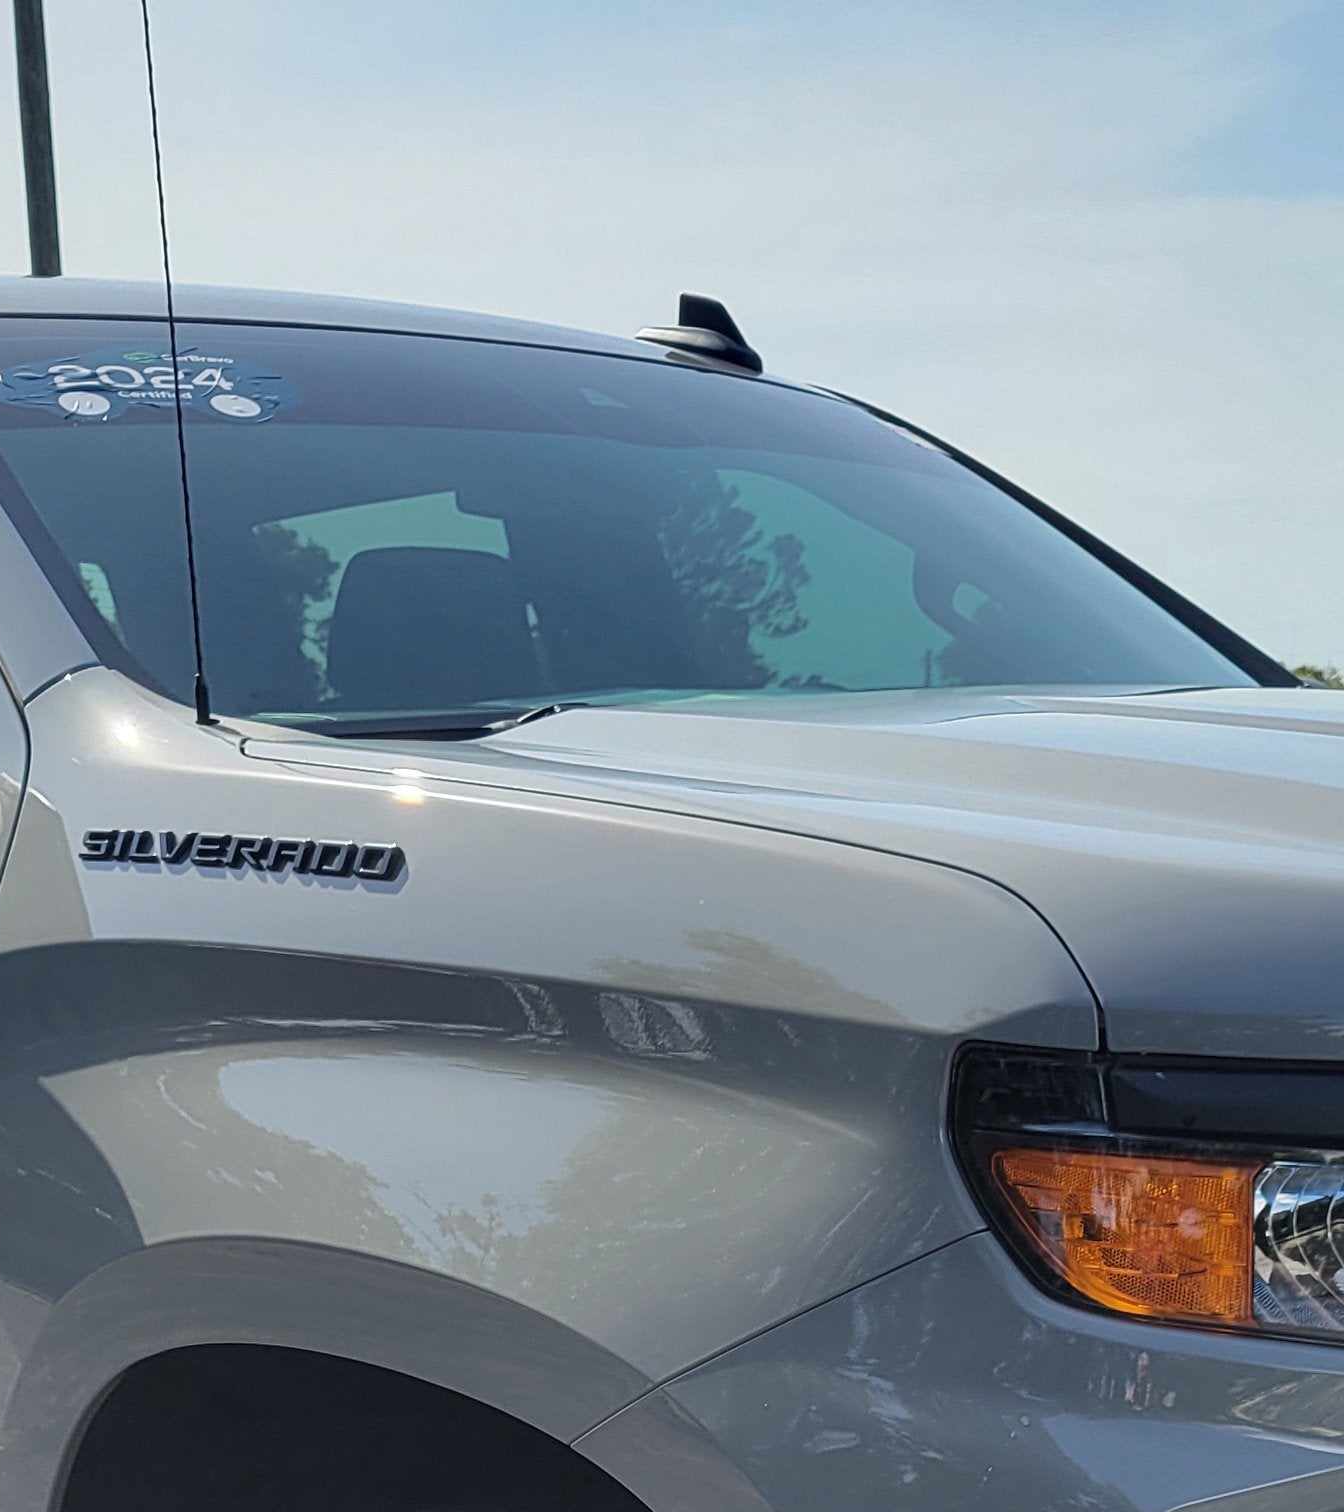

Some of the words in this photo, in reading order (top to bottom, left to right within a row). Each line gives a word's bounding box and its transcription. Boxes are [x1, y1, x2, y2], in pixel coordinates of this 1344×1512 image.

[48, 363, 235, 391] 2024
[117, 390, 193, 400] Certified
[79, 829, 408, 883] SILVERADO
